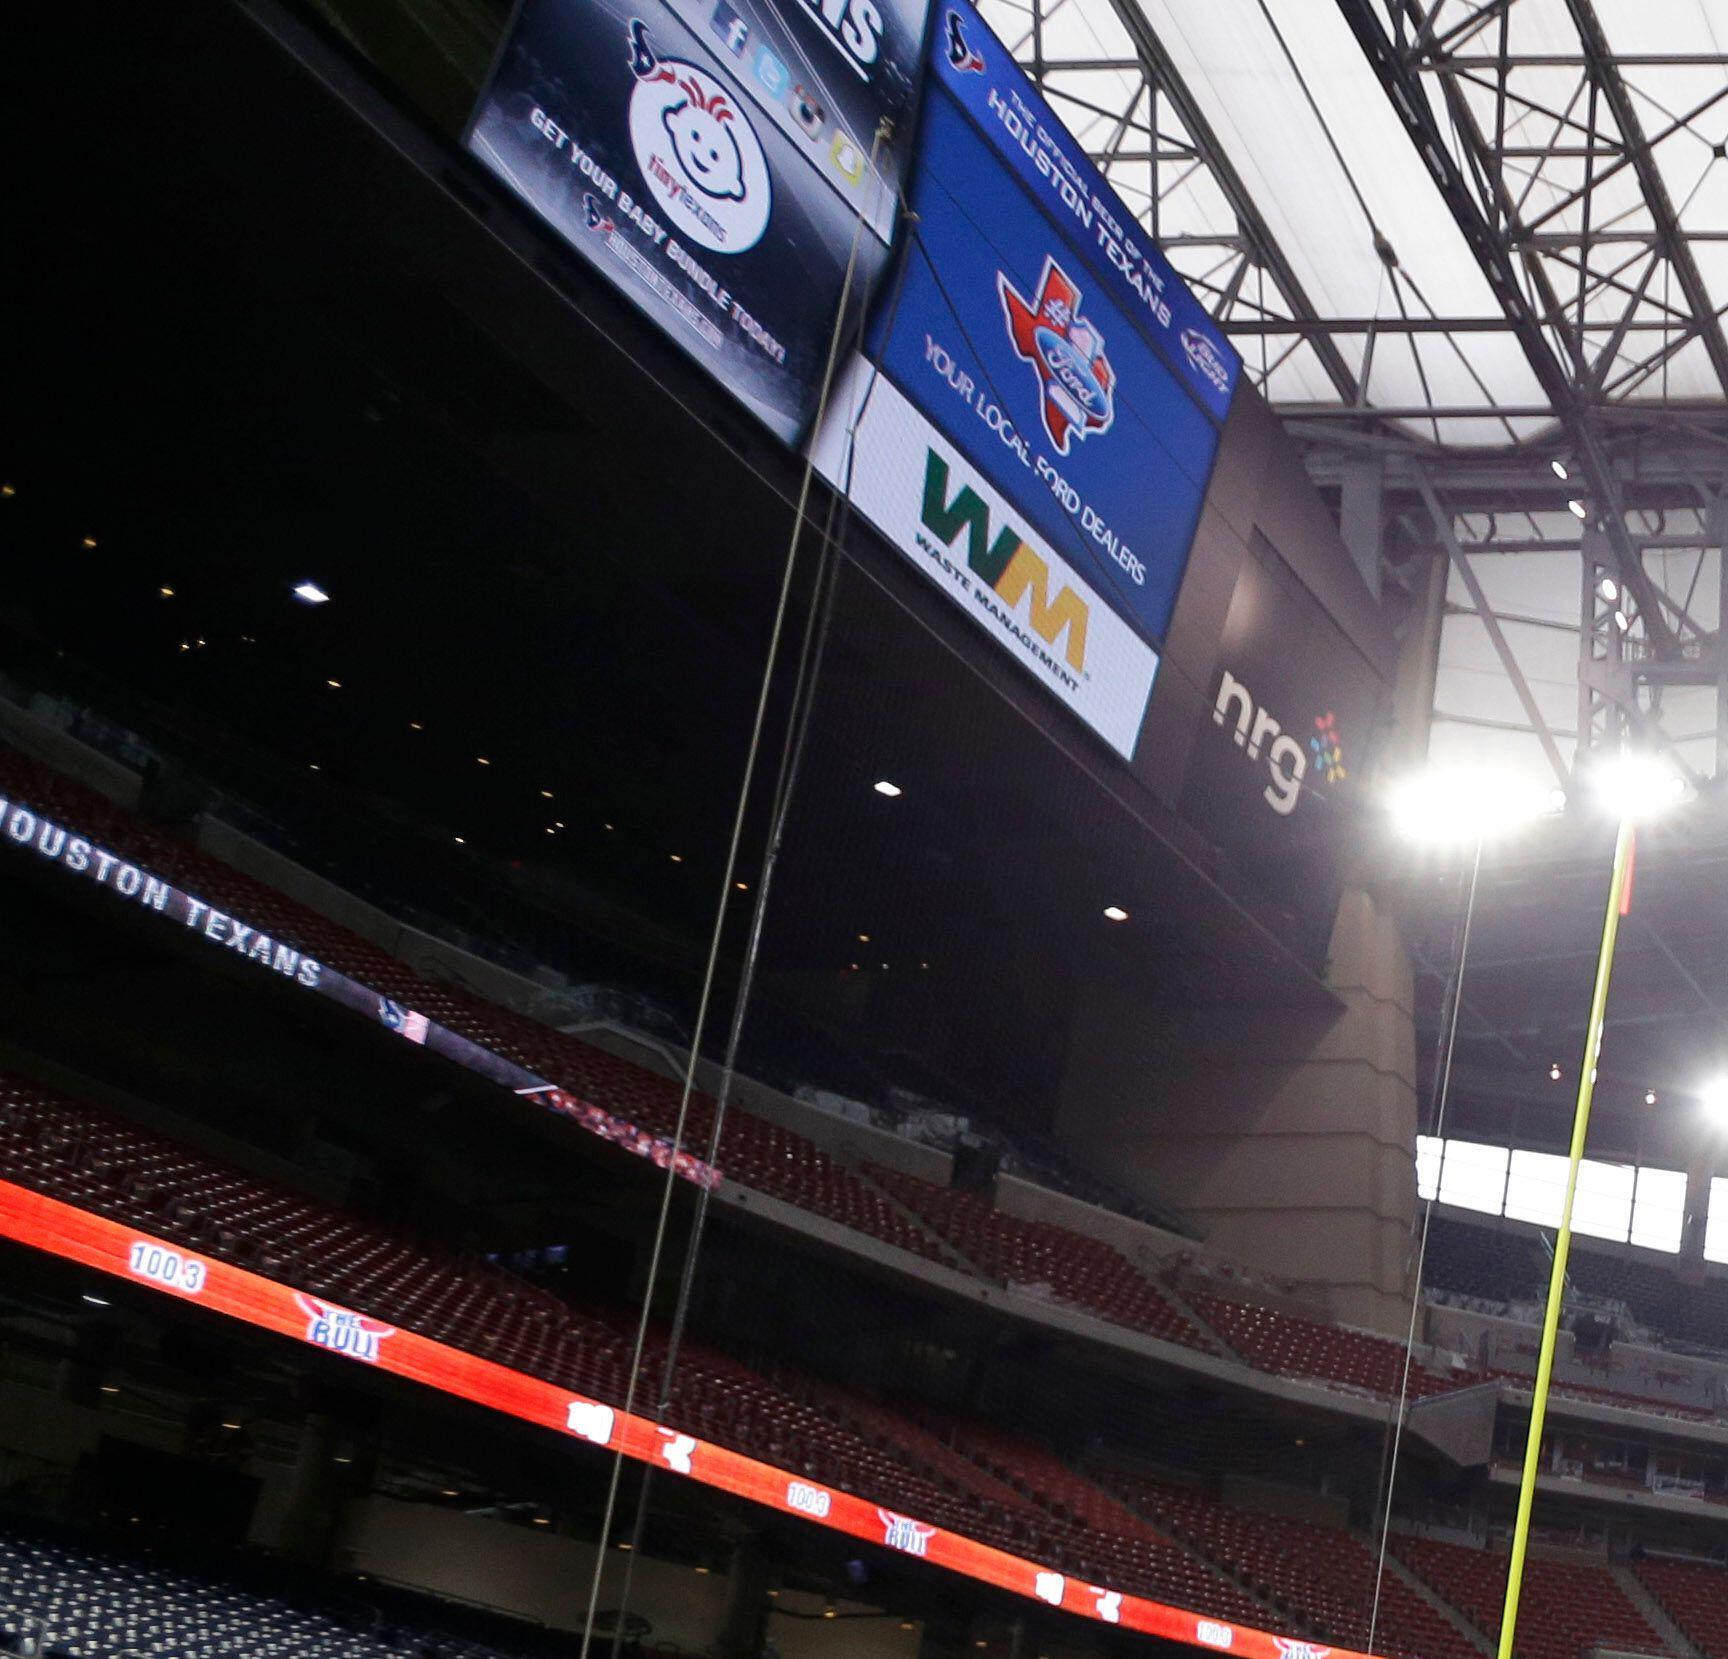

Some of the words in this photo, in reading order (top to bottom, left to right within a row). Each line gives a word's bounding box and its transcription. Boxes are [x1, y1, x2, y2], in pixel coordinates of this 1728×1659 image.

[530, 107, 569, 150] GET
[570, 143, 620, 200] YOUR
[617, 190, 668, 245] BABY
[666, 238, 732, 312] BUNDLE
[987, 87, 1093, 229] HOUSTON
[1096, 221, 1172, 329] TEXANS
[924, 334, 974, 403] YOUR
[976, 393, 1031, 468] LOCAL
[1034, 455, 1081, 515] FORD
[1080, 505, 1146, 586] DEALERS
[1048, 347, 1097, 407] Ford
[914, 532, 971, 592] WASTE
[974, 586, 1080, 694] MANAGEMENT
[920, 444, 1090, 673] WM
[1213, 670, 1307, 815] nrg
[0, 797, 171, 911] OUSTON
[186, 896, 322, 985] TEXANS
[132, 1243, 204, 1291] 100.3
